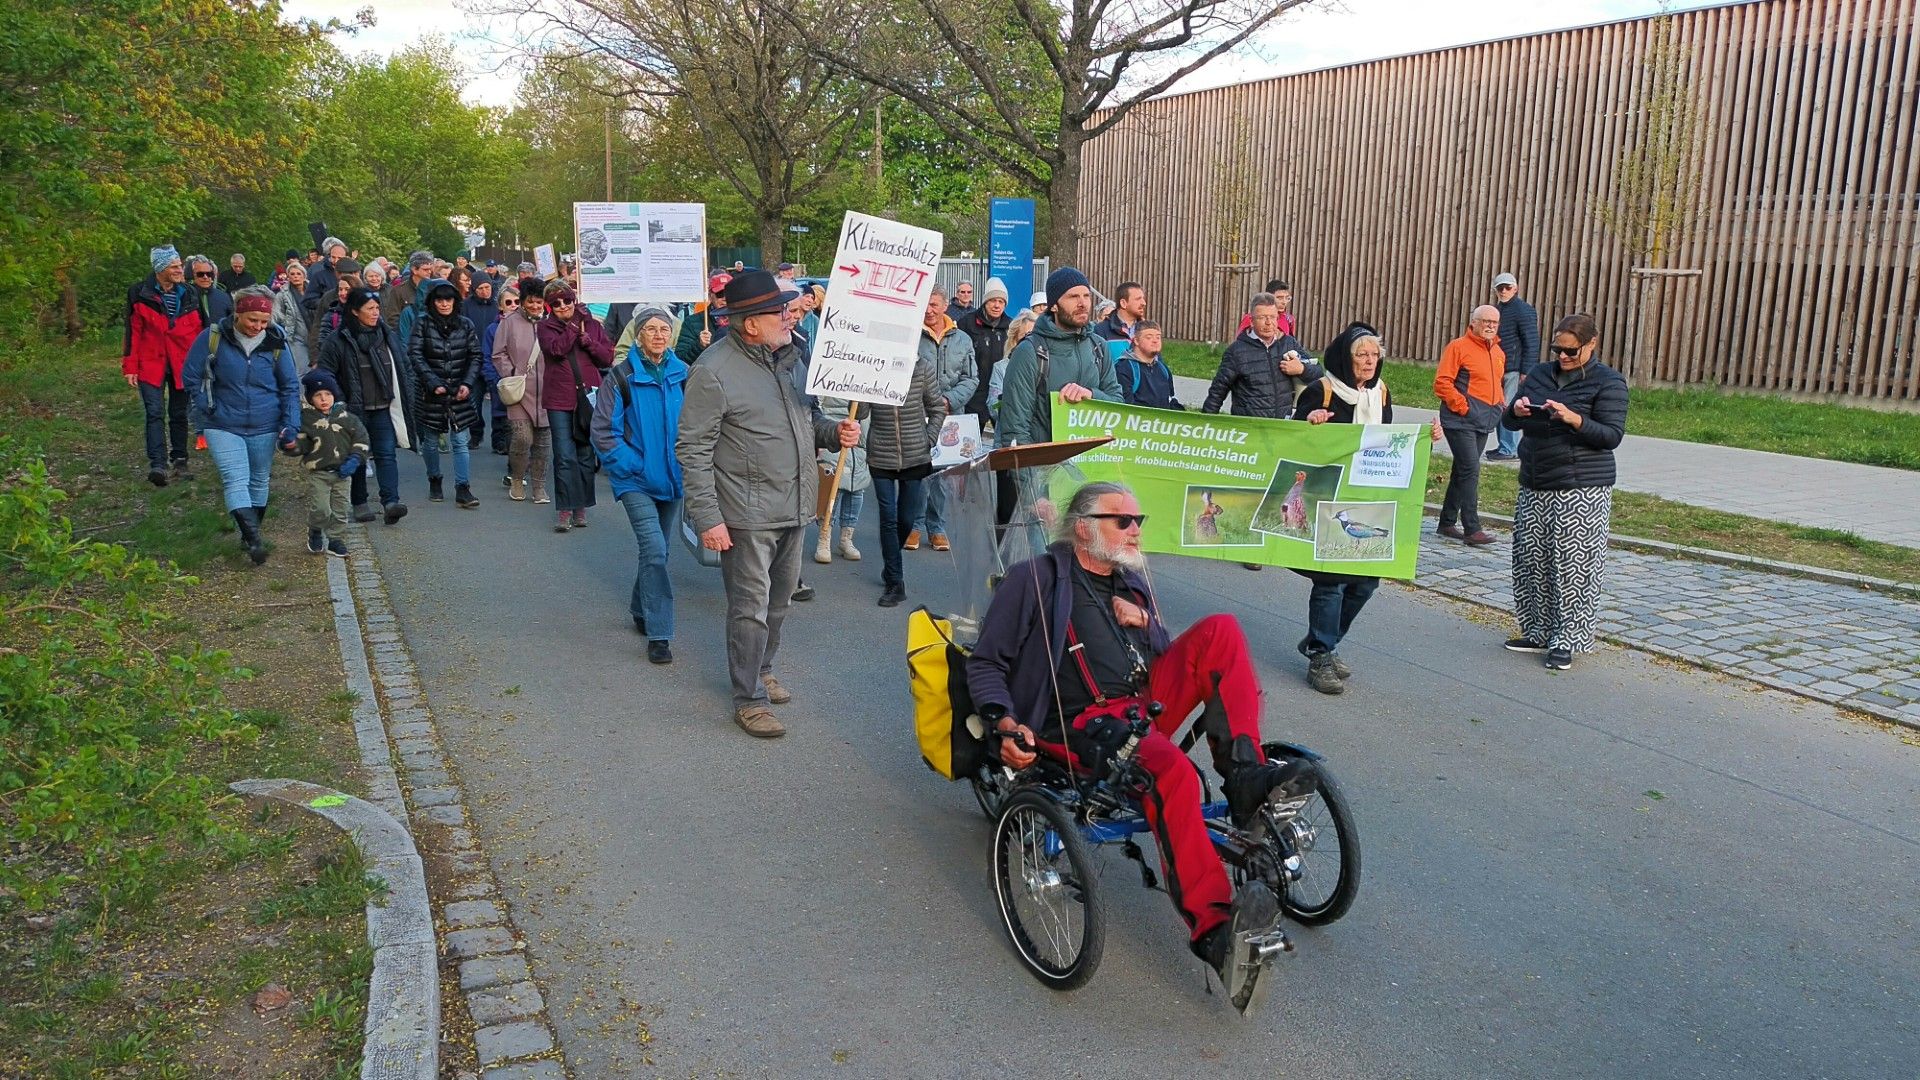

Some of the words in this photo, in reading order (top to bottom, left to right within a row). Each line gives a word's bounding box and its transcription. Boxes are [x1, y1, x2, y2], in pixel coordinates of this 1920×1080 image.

[855, 259, 928, 297] JETZT
[823, 306, 864, 333] Keine
[1067, 408, 1122, 429] BUND
[1125, 414, 1249, 445] Naturschutz
[1141, 437, 1259, 465] Knoblauchsland
[1363, 449, 1386, 458] BUND
[1088, 452, 1124, 463] schützen
[1134, 455, 1212, 473] Knoblauchsland
[1214, 464, 1267, 481] bewahren!
